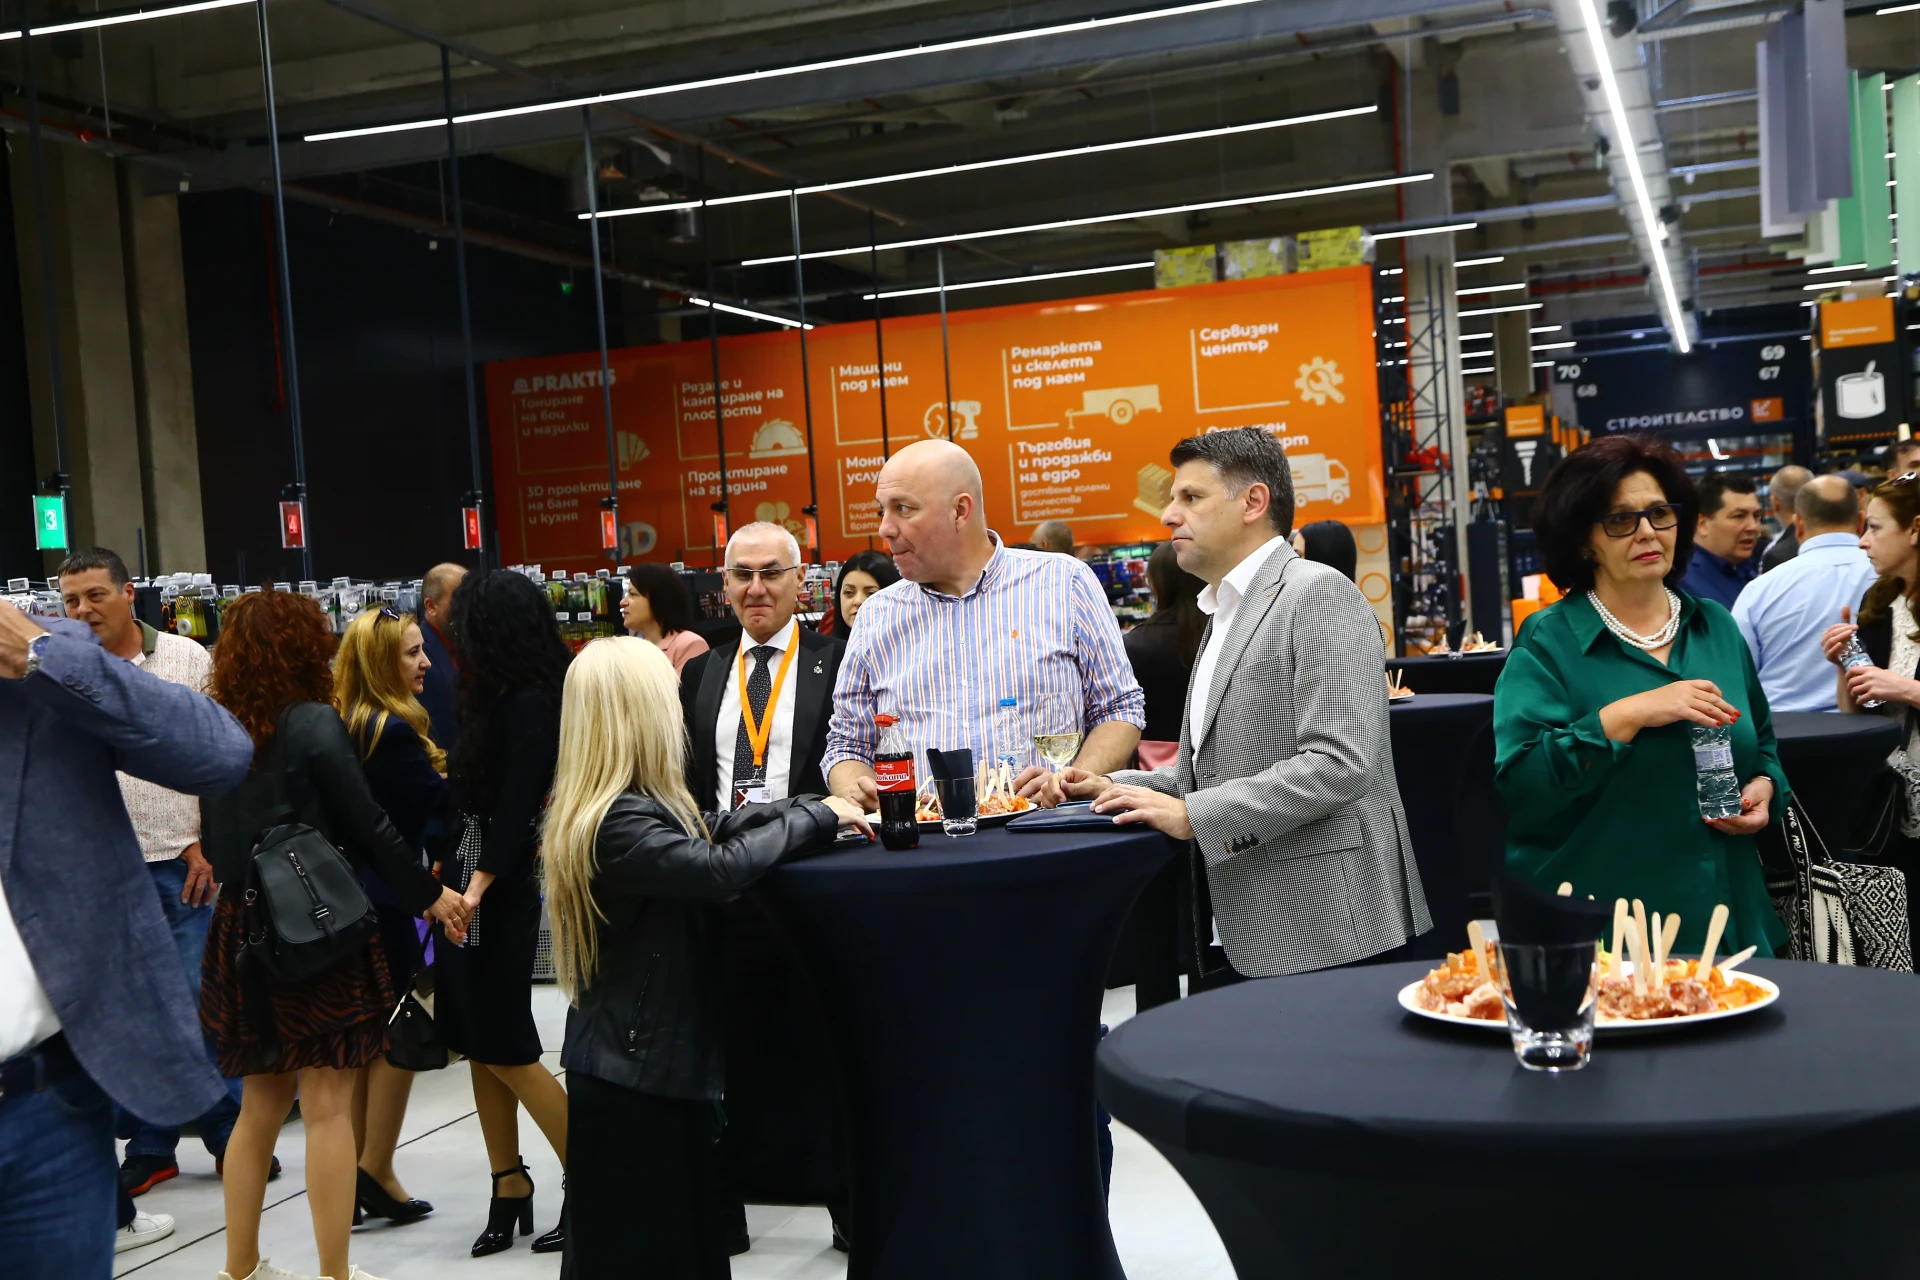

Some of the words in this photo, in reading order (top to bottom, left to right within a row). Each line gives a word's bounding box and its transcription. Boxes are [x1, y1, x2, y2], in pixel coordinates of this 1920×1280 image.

[1200, 322, 1279, 342] Сервизен
[1011, 340, 1103, 359] Ремаркета
[1200, 339, 1269, 357] център
[1760, 344, 1786, 361] 69
[1011, 363, 1022, 374] и
[1025, 356, 1094, 373] скелета
[1557, 364, 1581, 380] 70
[1758, 365, 1781, 380] 67
[532, 368, 616, 393] PRAKTIS
[682, 380, 729, 395] Рязае
[732, 379, 742, 389] и
[840, 380, 868, 393] под
[1013, 376, 1042, 391] под
[1046, 371, 1086, 386] наем
[766, 388, 784, 400] на
[1577, 383, 1598, 398] 68
[520, 394, 584, 410] Тониране
[521, 413, 538, 423] на
[540, 408, 565, 421] бои
[683, 405, 762, 422] плосости
[1606, 406, 1744, 431] СТРОИТЕЛСТВО
[522, 427, 531, 437] и
[1016, 436, 1092, 456] Търговия
[1018, 458, 1029, 469] и
[1031, 448, 1113, 470] продажби
[1019, 472, 1039, 484] на
[1041, 468, 1081, 485] едро
[527, 485, 544, 497] 3D
[689, 486, 706, 497] на
[528, 500, 544, 511] на
[546, 497, 579, 510] баня
[46, 510, 56, 530] 3
[288, 515, 298, 533] 4
[469, 518, 476, 535] 5
[528, 515, 537, 525] и
[540, 511, 579, 526] кухня
